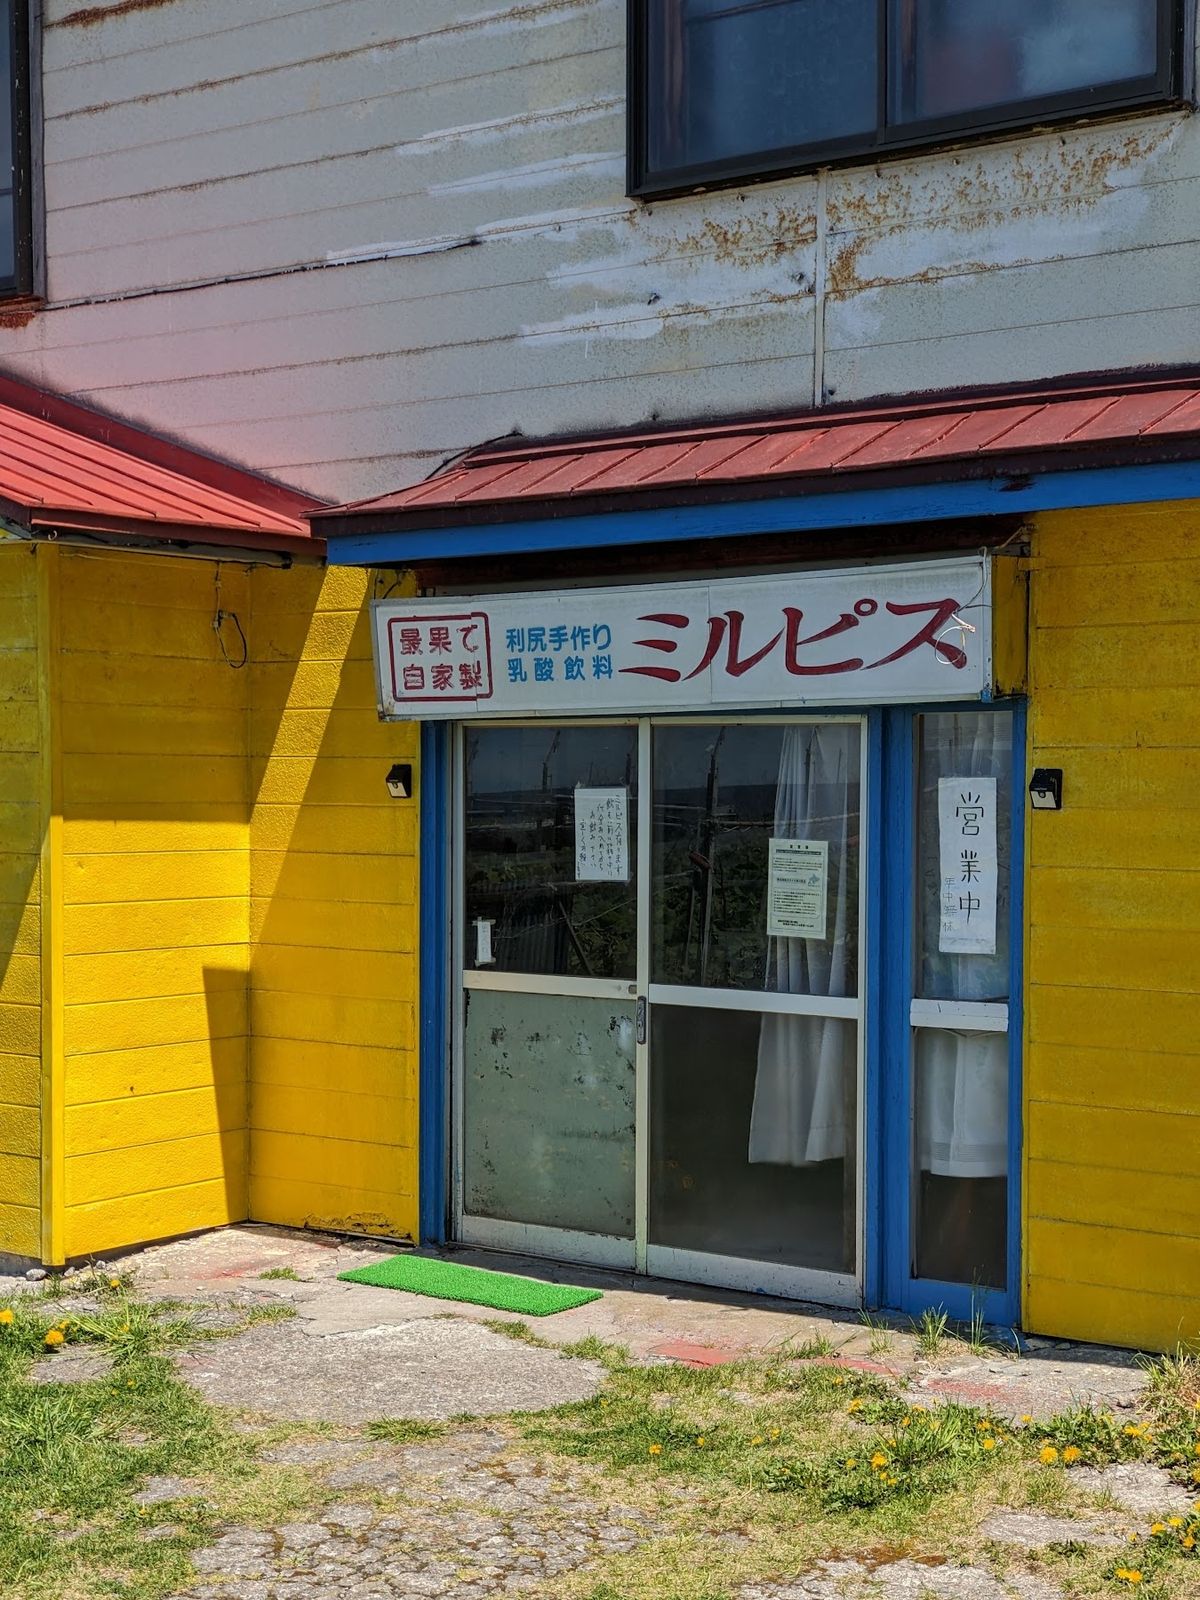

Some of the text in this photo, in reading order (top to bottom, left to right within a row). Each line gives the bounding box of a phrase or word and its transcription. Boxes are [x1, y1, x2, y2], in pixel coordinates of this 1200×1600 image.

[399, 624, 480, 656] 最果て
[505, 623, 613, 653] 利尻手作り
[618, 598, 967, 683] ミルピス
[402, 660, 483, 691] 自家製
[507, 654, 613, 682] 乳酸飲料
[955, 791, 984, 926] 営業中
